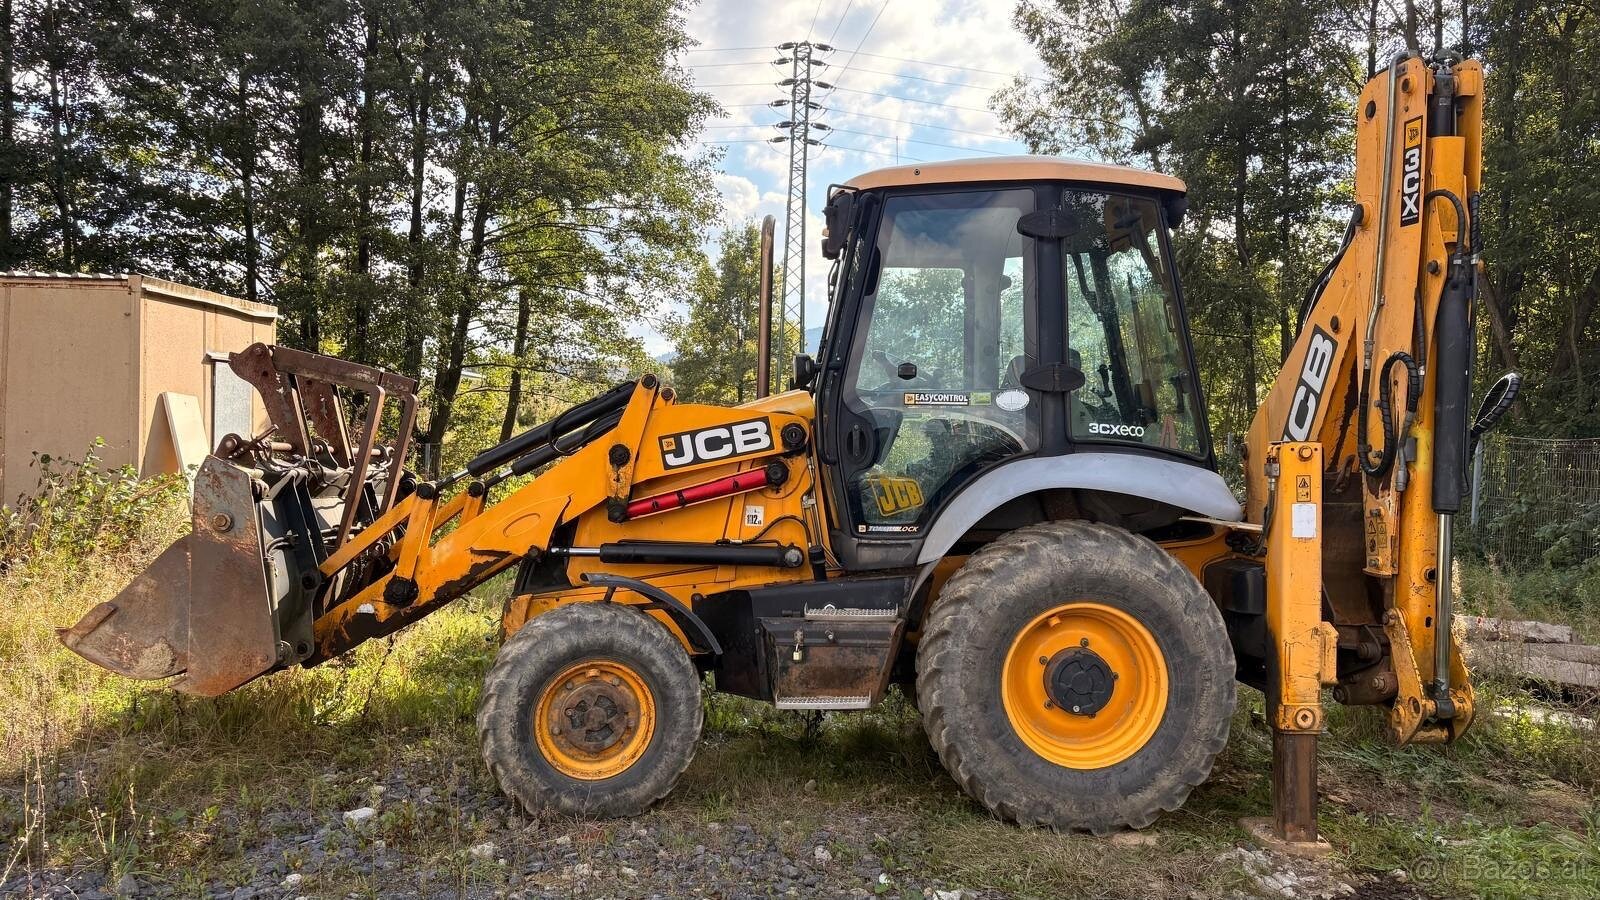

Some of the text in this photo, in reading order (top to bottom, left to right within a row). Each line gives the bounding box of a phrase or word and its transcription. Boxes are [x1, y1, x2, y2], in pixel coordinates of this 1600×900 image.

[1402, 148, 1420, 217] 3CX
[915, 393, 968, 403] EASYCONTROL
[1283, 333, 1333, 442] CB
[664, 421, 771, 466] JCB
[1088, 422, 1145, 437] 3CXeco
[879, 479, 921, 512] JCB
